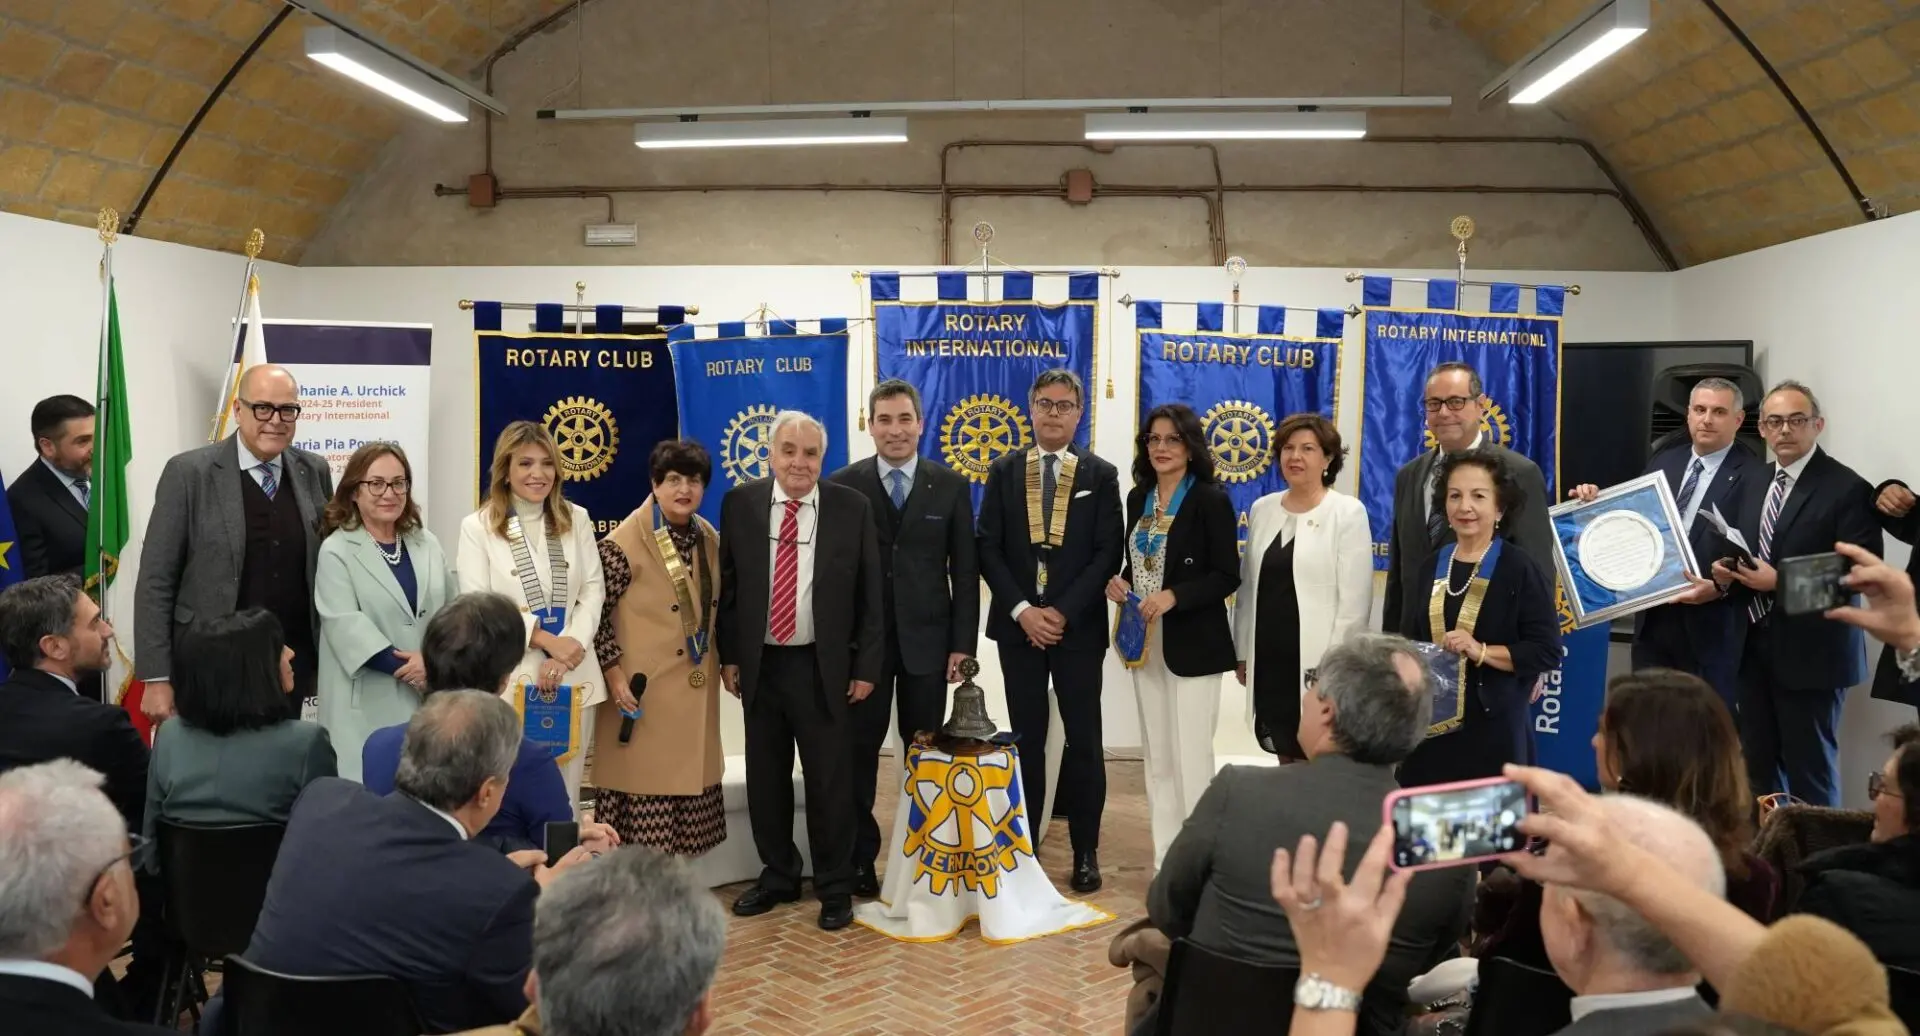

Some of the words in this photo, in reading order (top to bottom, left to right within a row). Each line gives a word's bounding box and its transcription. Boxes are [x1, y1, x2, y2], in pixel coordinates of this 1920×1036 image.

[944, 314, 1026, 332] ROTARY
[1378, 325, 1439, 340] ROTARY
[906, 339, 1068, 358] INTERNATIONAL
[1163, 341, 1250, 365] ROTARY
[1257, 346, 1315, 368] CLUB
[506, 348, 590, 368] ROTARY
[598, 350, 654, 368] CLUB
[706, 359, 765, 377] ROTARY
[776, 357, 812, 373] CLUB
[341, 385, 353, 396] A.
[357, 385, 407, 397] Urchick
[336, 399, 382, 408] President
[325, 411, 390, 420] International
[564, 407, 598, 419] ROTARY
[968, 405, 1004, 417] ROTARY
[1221, 411, 1255, 421] ROTARY
[294, 438, 321, 450] aria
[325, 438, 345, 450] Pia
